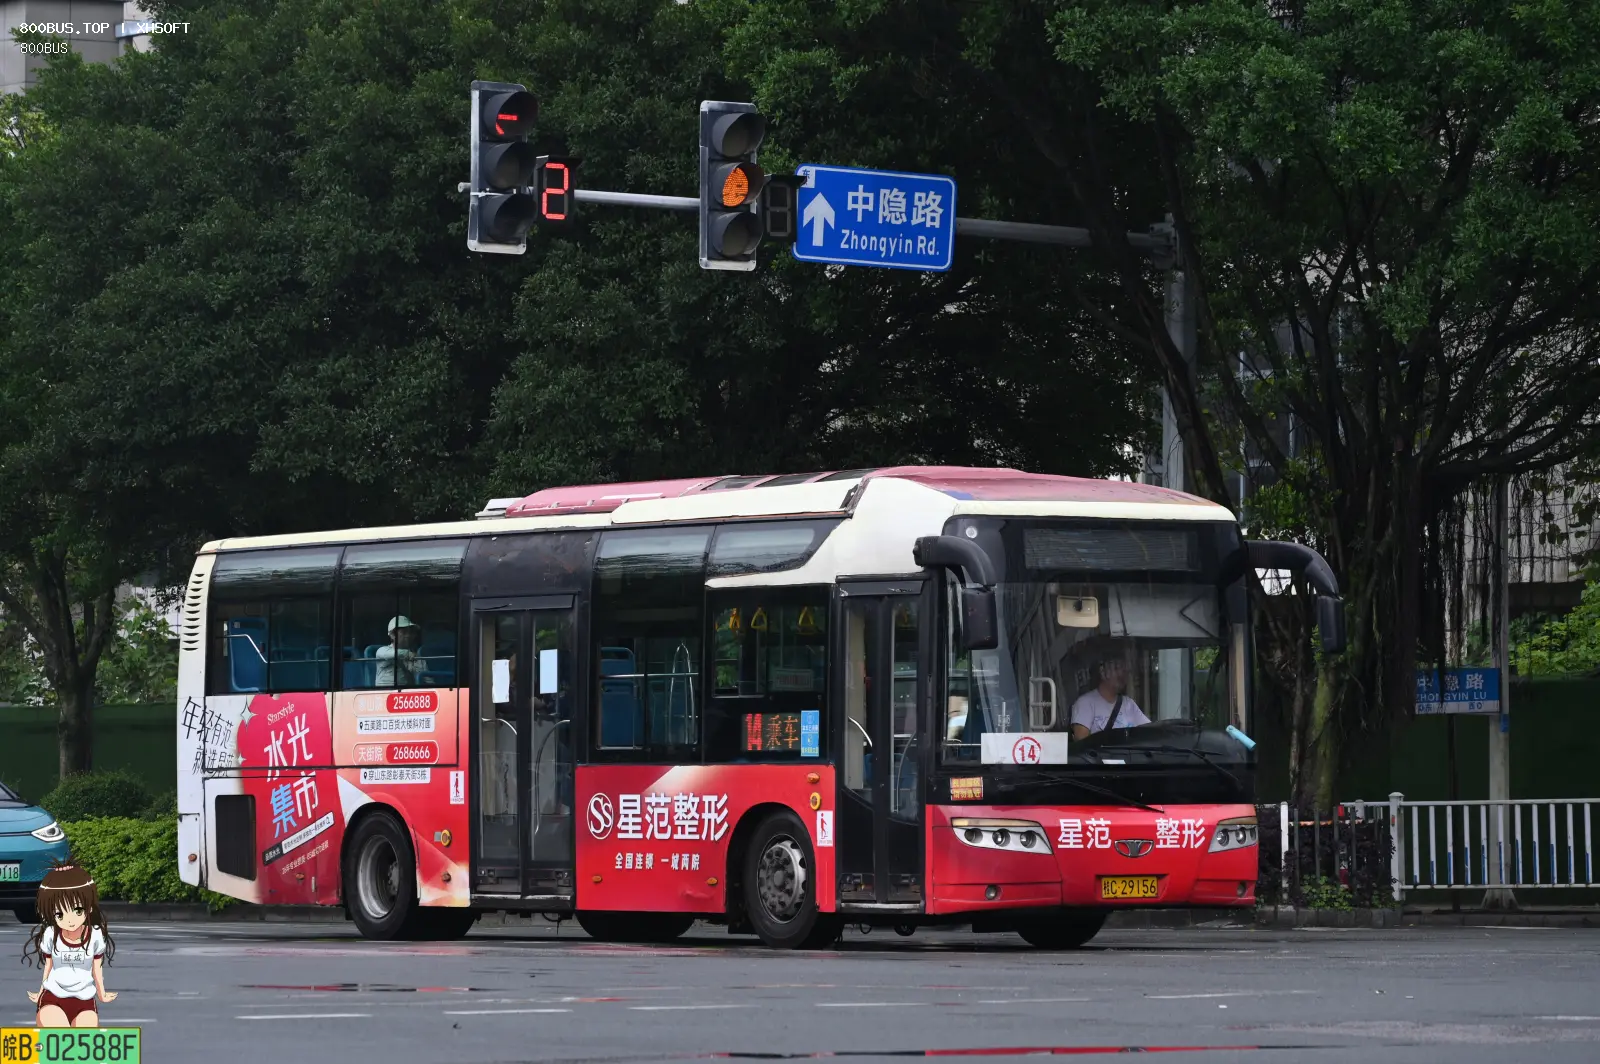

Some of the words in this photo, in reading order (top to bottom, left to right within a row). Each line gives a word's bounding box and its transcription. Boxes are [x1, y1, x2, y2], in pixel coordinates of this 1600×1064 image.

[541, 162, 569, 221] 2
[847, 184, 944, 229] 中隐路
[840, 229, 913, 258] Zhongyin
[917, 235, 940, 256] Rd.
[393, 694, 431, 710] 2566888
[1473, 691, 1487, 700] LU
[267, 701, 295, 726] Starstyle
[263, 713, 313, 783] 水光
[358, 746, 383, 762] 天街院
[393, 745, 430, 760] 2686666
[1018, 744, 1037, 762] 14
[270, 770, 319, 838] 集市
[617, 792, 729, 841] 星范整形
[1057, 816, 1112, 850] 星范
[1155, 816, 1206, 850] 整形
[0, 867, 19, 879] 118
[614, 852, 654, 870] 全国连锁
[660, 853, 700, 871] 一城两院
